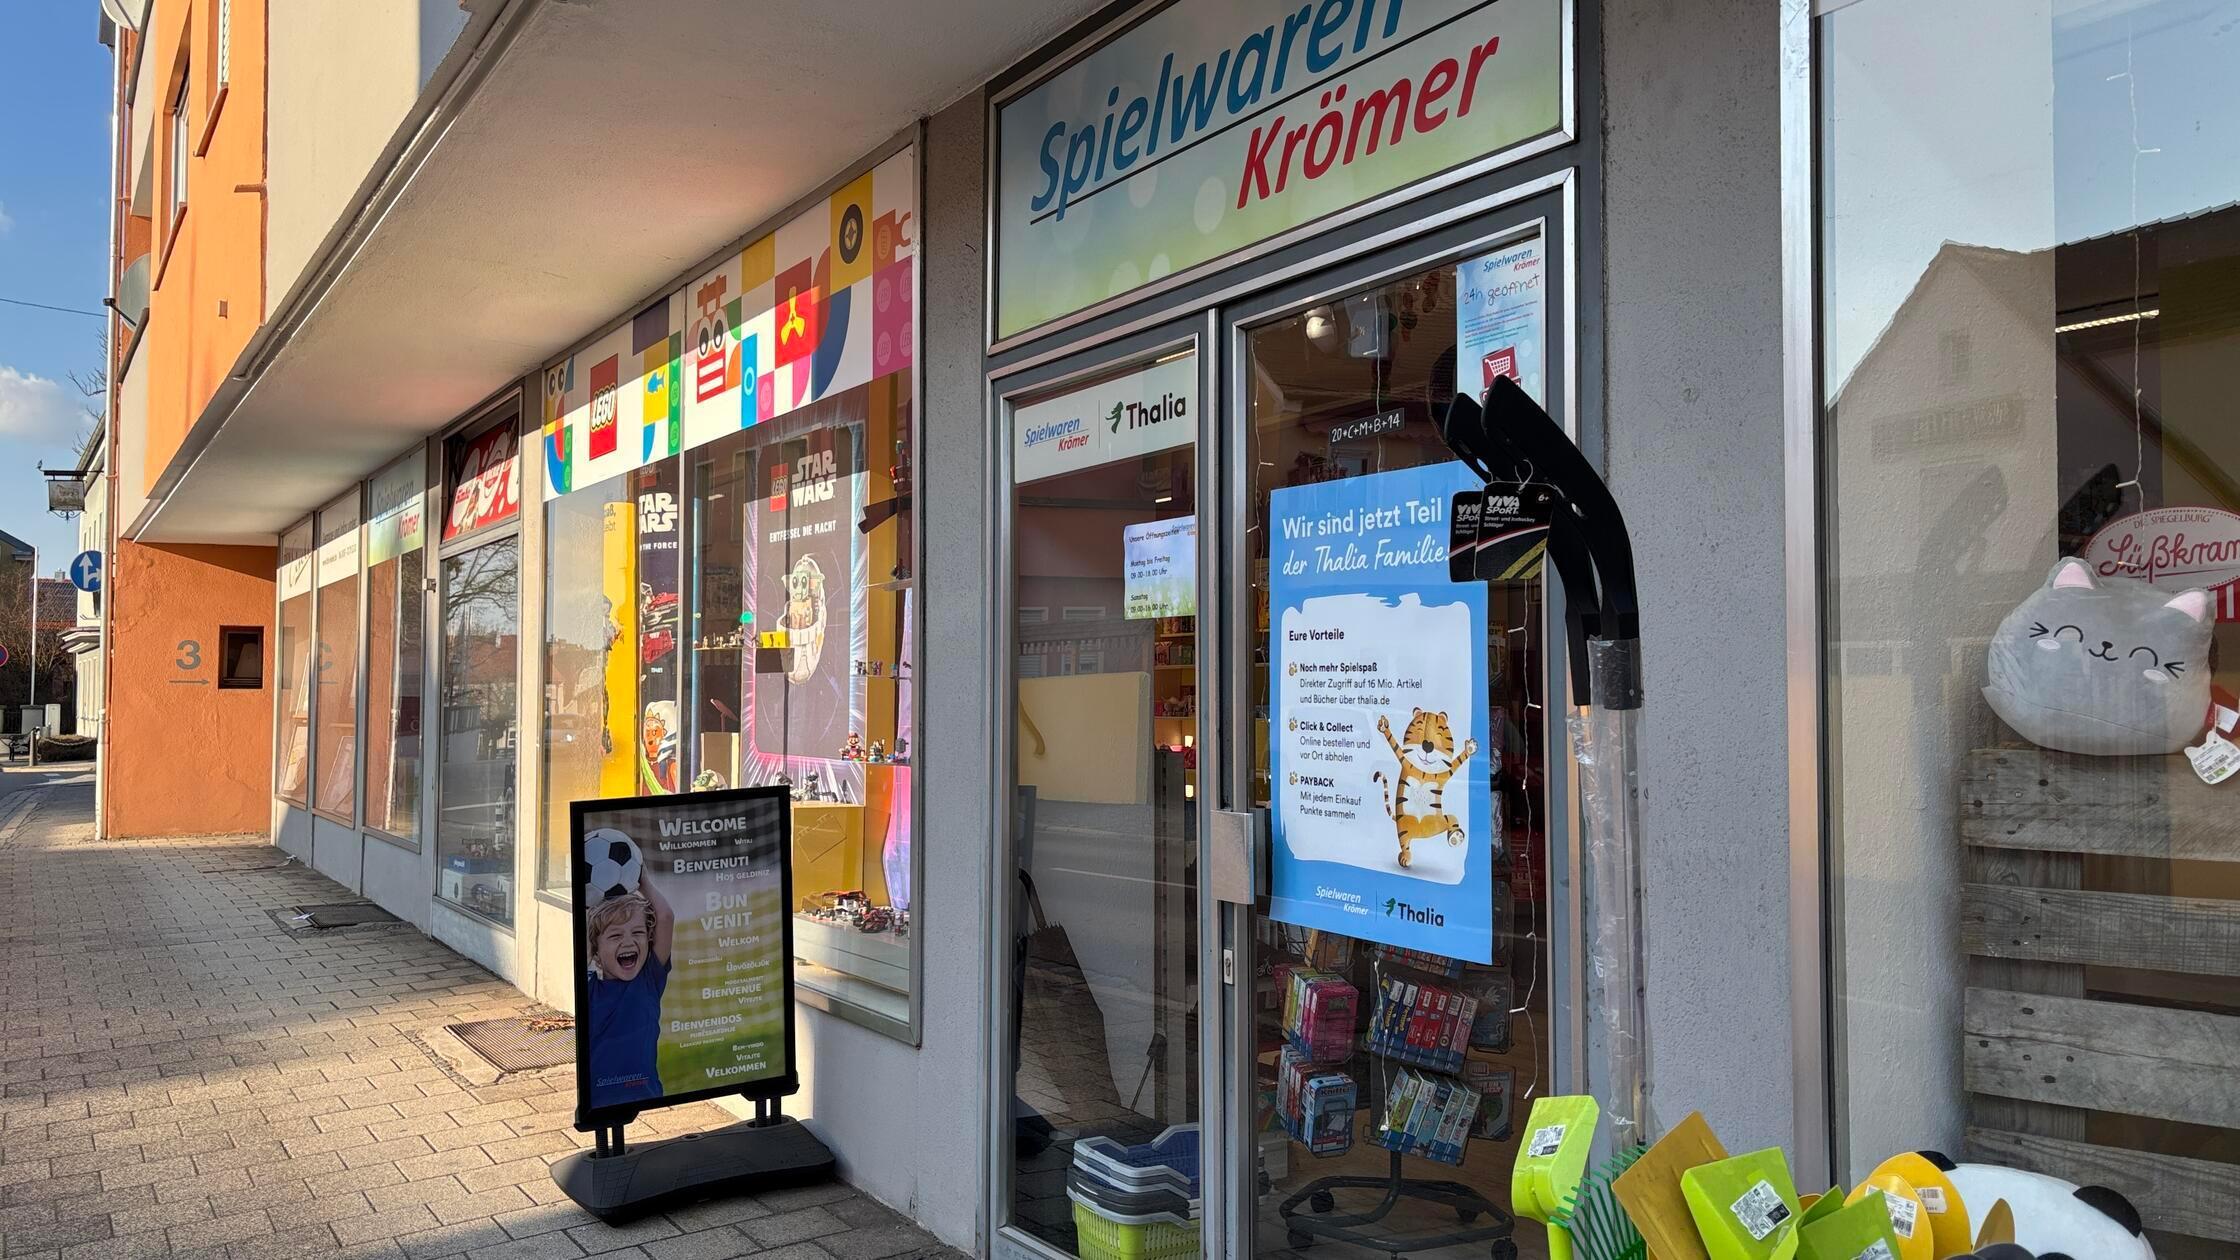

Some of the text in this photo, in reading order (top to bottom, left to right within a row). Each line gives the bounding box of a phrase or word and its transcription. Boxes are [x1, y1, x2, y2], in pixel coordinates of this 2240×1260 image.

[1031, 0, 1402, 222] Spielwaren
[1237, 36, 1500, 210] Krömer
[1483, 249, 1533, 273] Spielwaren
[1463, 286, 1484, 305] 24h
[592, 384, 616, 430] LEGO
[1125, 392, 1187, 430] Thalia
[1024, 417, 1081, 448] Spielwaren
[1057, 433, 1090, 452] Krömer
[792, 450, 837, 484] STAR
[792, 474, 837, 508] WARS
[639, 492, 678, 514] TAR
[640, 512, 678, 534] ARS
[1282, 497, 1442, 540] Wir sind jetzt Teil
[802, 525, 814, 536] DIE
[653, 541, 678, 550] FORCE
[1282, 550, 1308, 576] der
[1313, 543, 1369, 574] Thalia
[1288, 627, 1345, 642] Eure Vorteile
[175, 639, 202, 671] 3
[1299, 662, 1378, 674] Noch mehr Spielspaß
[1299, 678, 1423, 691] Direkter Zugriff auf 16 Mio. Artikel
[1299, 693, 1390, 705] und Bücher über thalia.de
[1299, 721, 1354, 733] Click & Collect
[1299, 736, 1371, 749] Online bestellen und
[1299, 751, 1354, 763] vor Ort abholen
[1300, 775, 1334, 788] PAYBACK
[1300, 791, 1362, 806] Mit jedem Einkauf
[1299, 805, 1356, 820] Punkte sammeln
[1316, 884, 1361, 905] Spielwaren
[1343, 903, 1369, 916] Krömer
[1397, 903, 1445, 927] Thalia
